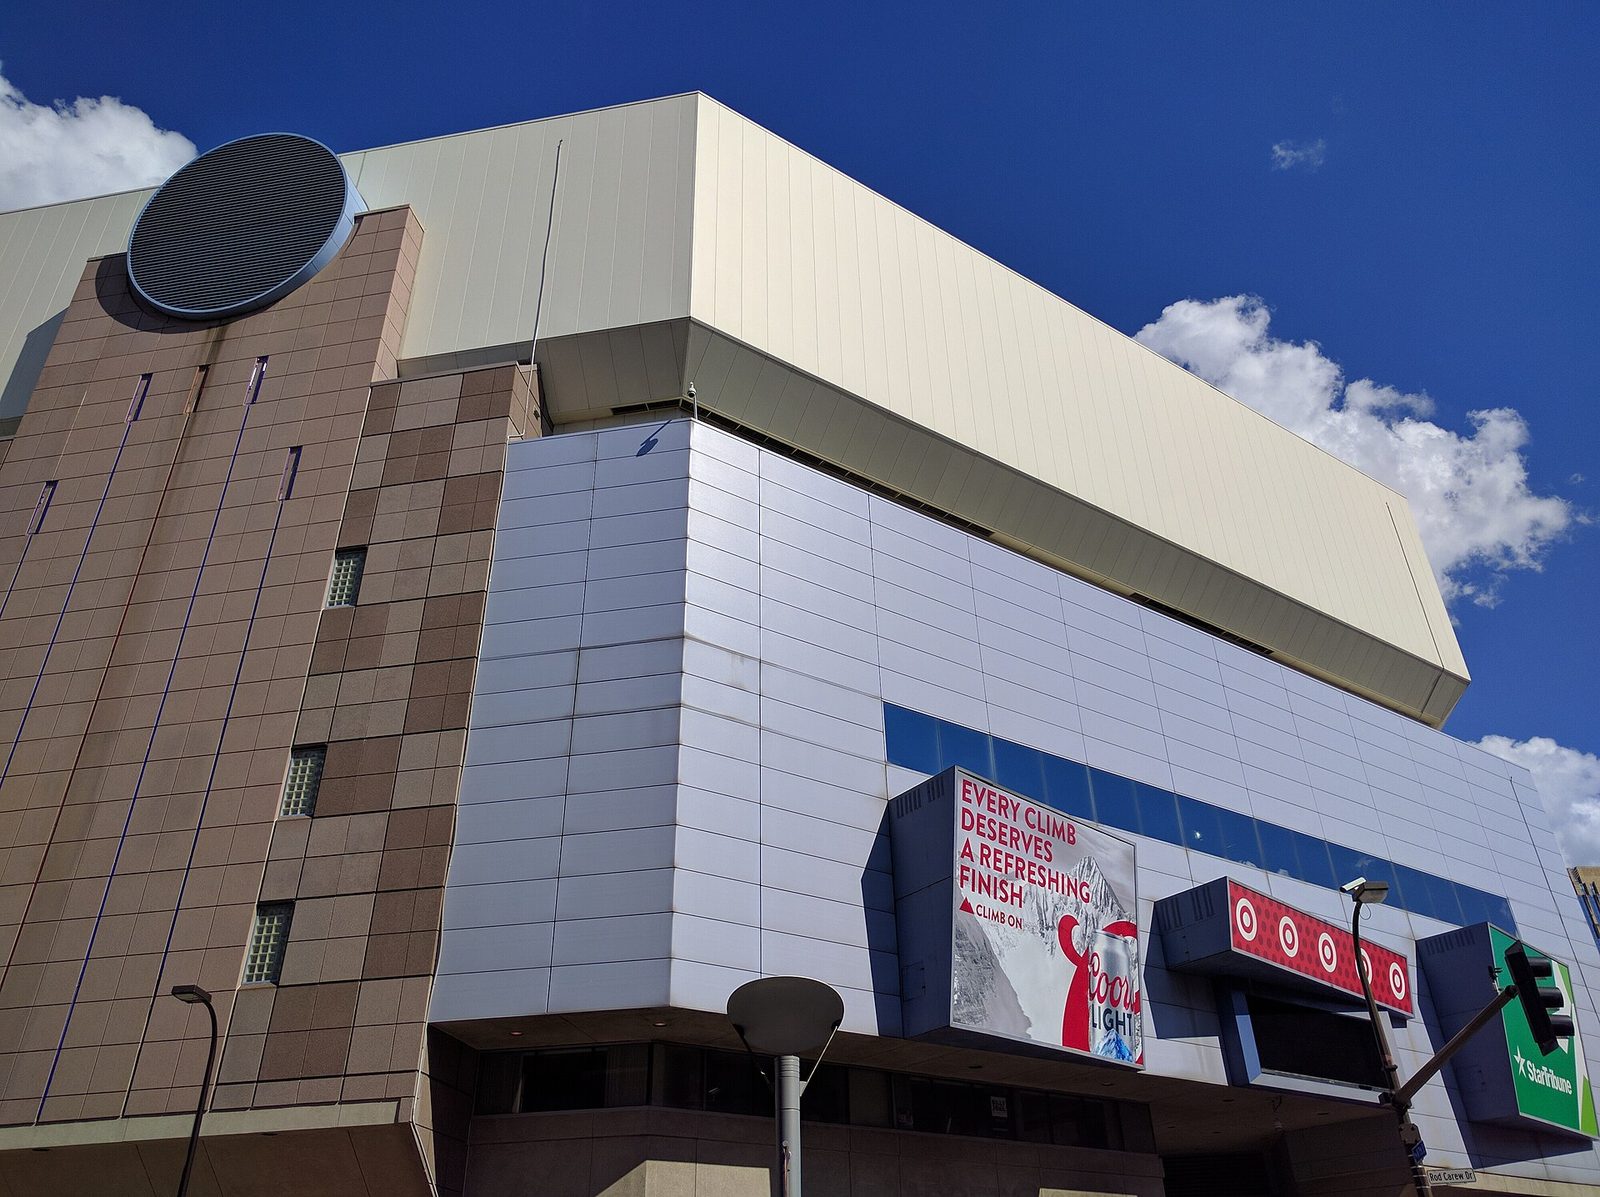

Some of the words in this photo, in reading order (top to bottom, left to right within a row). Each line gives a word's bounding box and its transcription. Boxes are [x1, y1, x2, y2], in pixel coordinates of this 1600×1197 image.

[962, 779, 1021, 822] EVERY
[1024, 807, 1076, 845] CLIMB
[961, 807, 1053, 863] DESERVES
[959, 865, 1023, 908] FINISH
[960, 837, 974, 863] A
[980, 843, 1090, 904] REFRESHING
[976, 904, 1005, 924] CLIMB
[1007, 915, 1023, 930] ON
[1091, 1004, 1132, 1036] LIGHT
[1526, 1060, 1573, 1095] StarTribune
[1429, 1173, 1442, 1181] Rod
[1444, 1172, 1464, 1180] Carew
[1465, 1171, 1474, 1179] Dr
